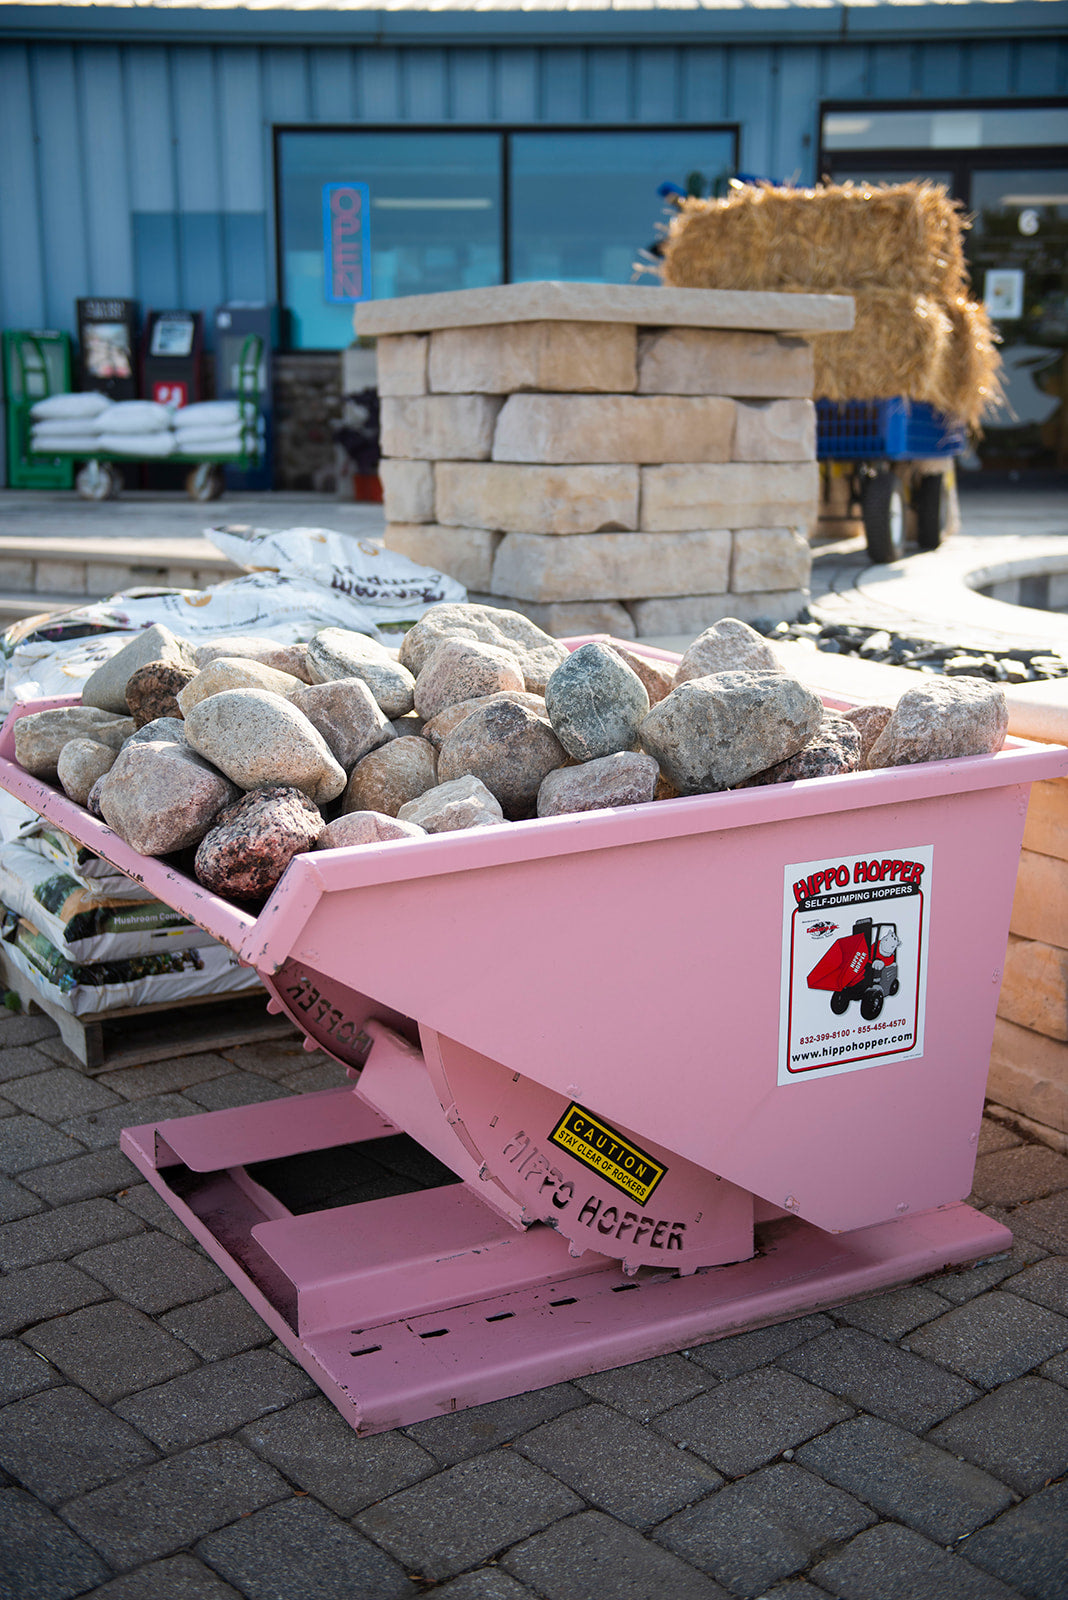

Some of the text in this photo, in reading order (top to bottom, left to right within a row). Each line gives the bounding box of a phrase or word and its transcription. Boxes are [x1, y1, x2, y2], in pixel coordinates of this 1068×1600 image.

[330, 187, 362, 298] OPEN
[793, 859, 925, 903] HIPPO HOPPER
[805, 885, 912, 908] SELF-DUMPING HOPPERS
[114, 914, 158, 925] Mushroom
[850, 951, 861, 968] HIPPO
[853, 952, 867, 973] HOPPER
[800, 1018, 906, 1045] 832-399-8100 855-456-4570
[792, 1033, 912, 1062] www.hippohopper.com
[558, 1130, 646, 1196] STAY CLEAR OF ROCKERS
[573, 1120, 647, 1177] CAUTION
[503, 1130, 686, 1250] HIPPO HOPPER
